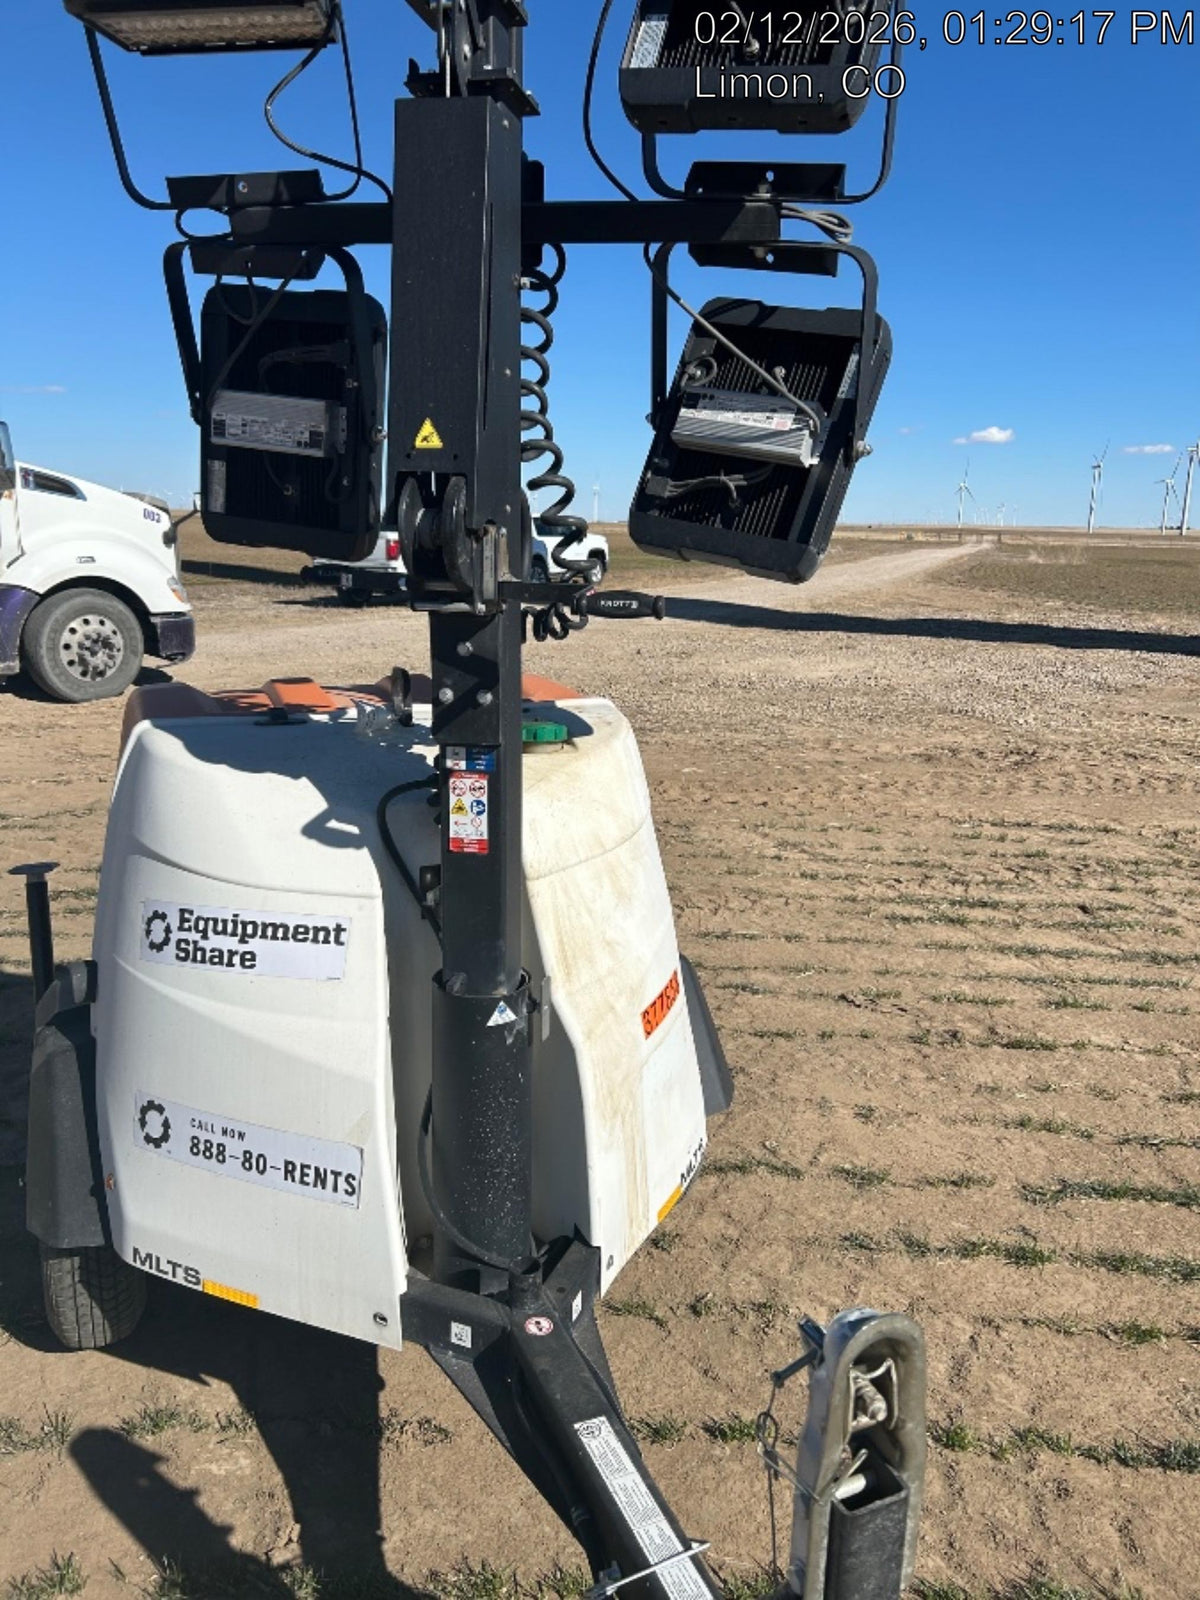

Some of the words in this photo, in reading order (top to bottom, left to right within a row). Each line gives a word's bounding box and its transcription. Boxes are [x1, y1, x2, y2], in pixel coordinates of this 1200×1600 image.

[177, 908, 347, 946] Equipment
[175, 938, 257, 970] Share
[189, 1117, 216, 1134] CALL
[221, 1126, 247, 1142] NOW
[189, 1135, 357, 1197] 888-80-RENTS
[132, 1246, 202, 1286] MLTS
